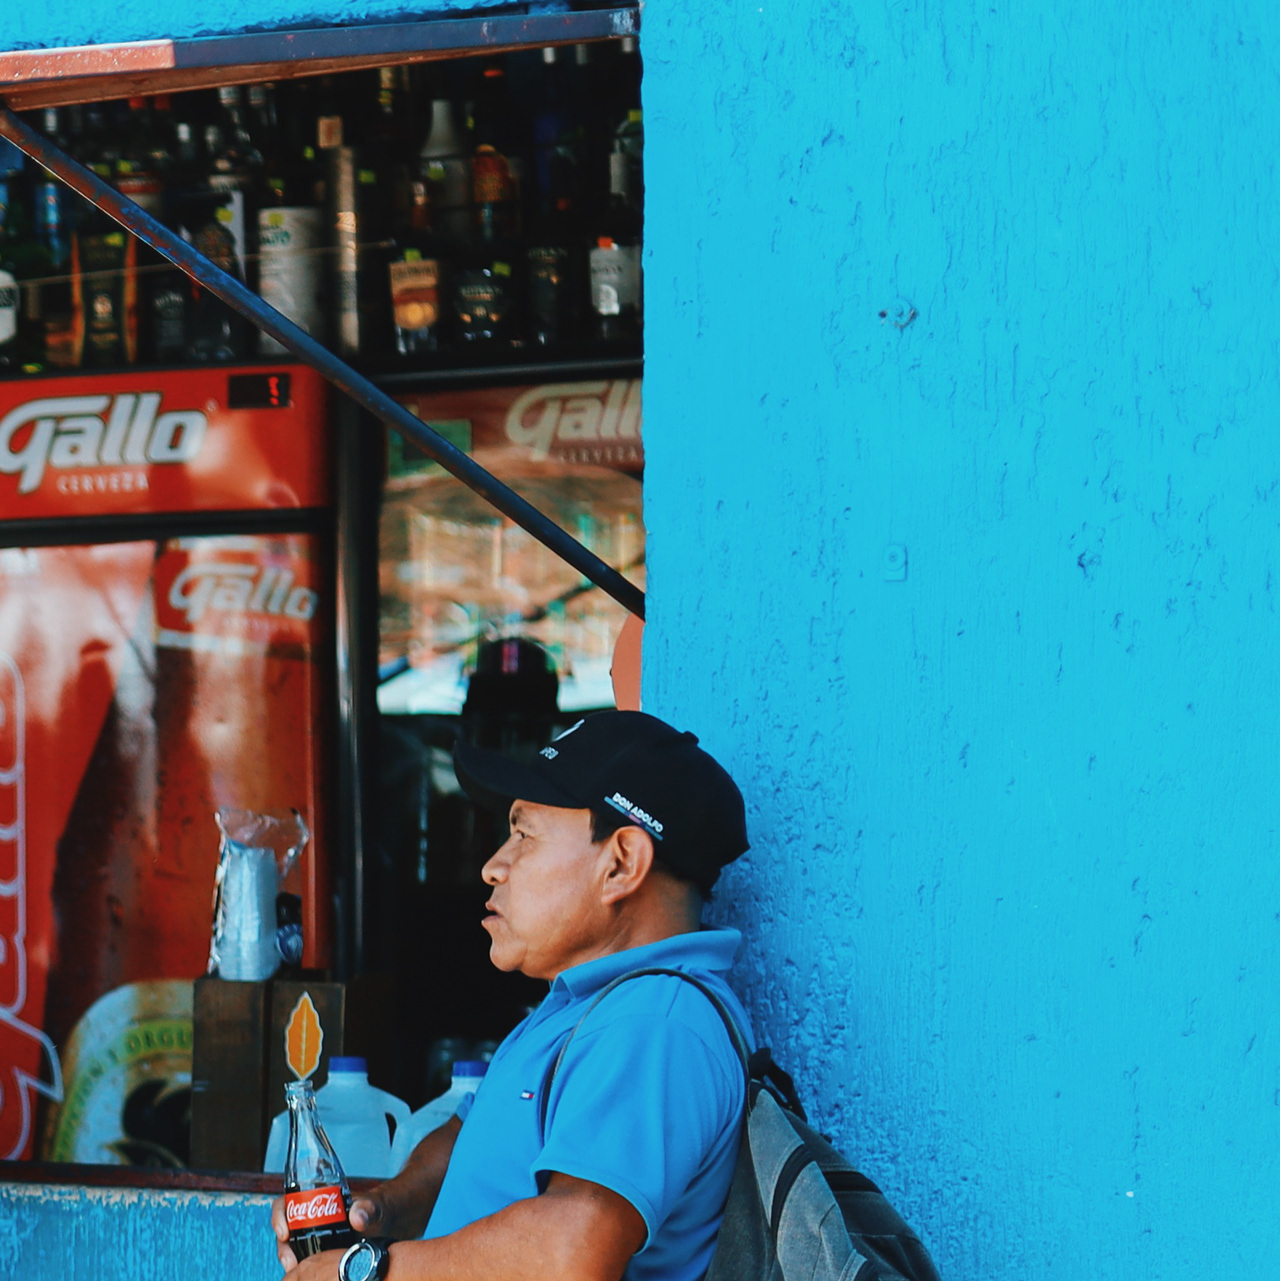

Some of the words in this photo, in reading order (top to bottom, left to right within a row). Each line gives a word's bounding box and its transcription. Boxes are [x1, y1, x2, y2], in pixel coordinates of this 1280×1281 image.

[505, 379, 643, 462] Gall
[56, 471, 150, 495] CERVEZA
[612, 791, 634, 812] DON
[630, 805, 664, 833] ADOLFO
[286, 1192, 339, 1223] Coca-Cola
